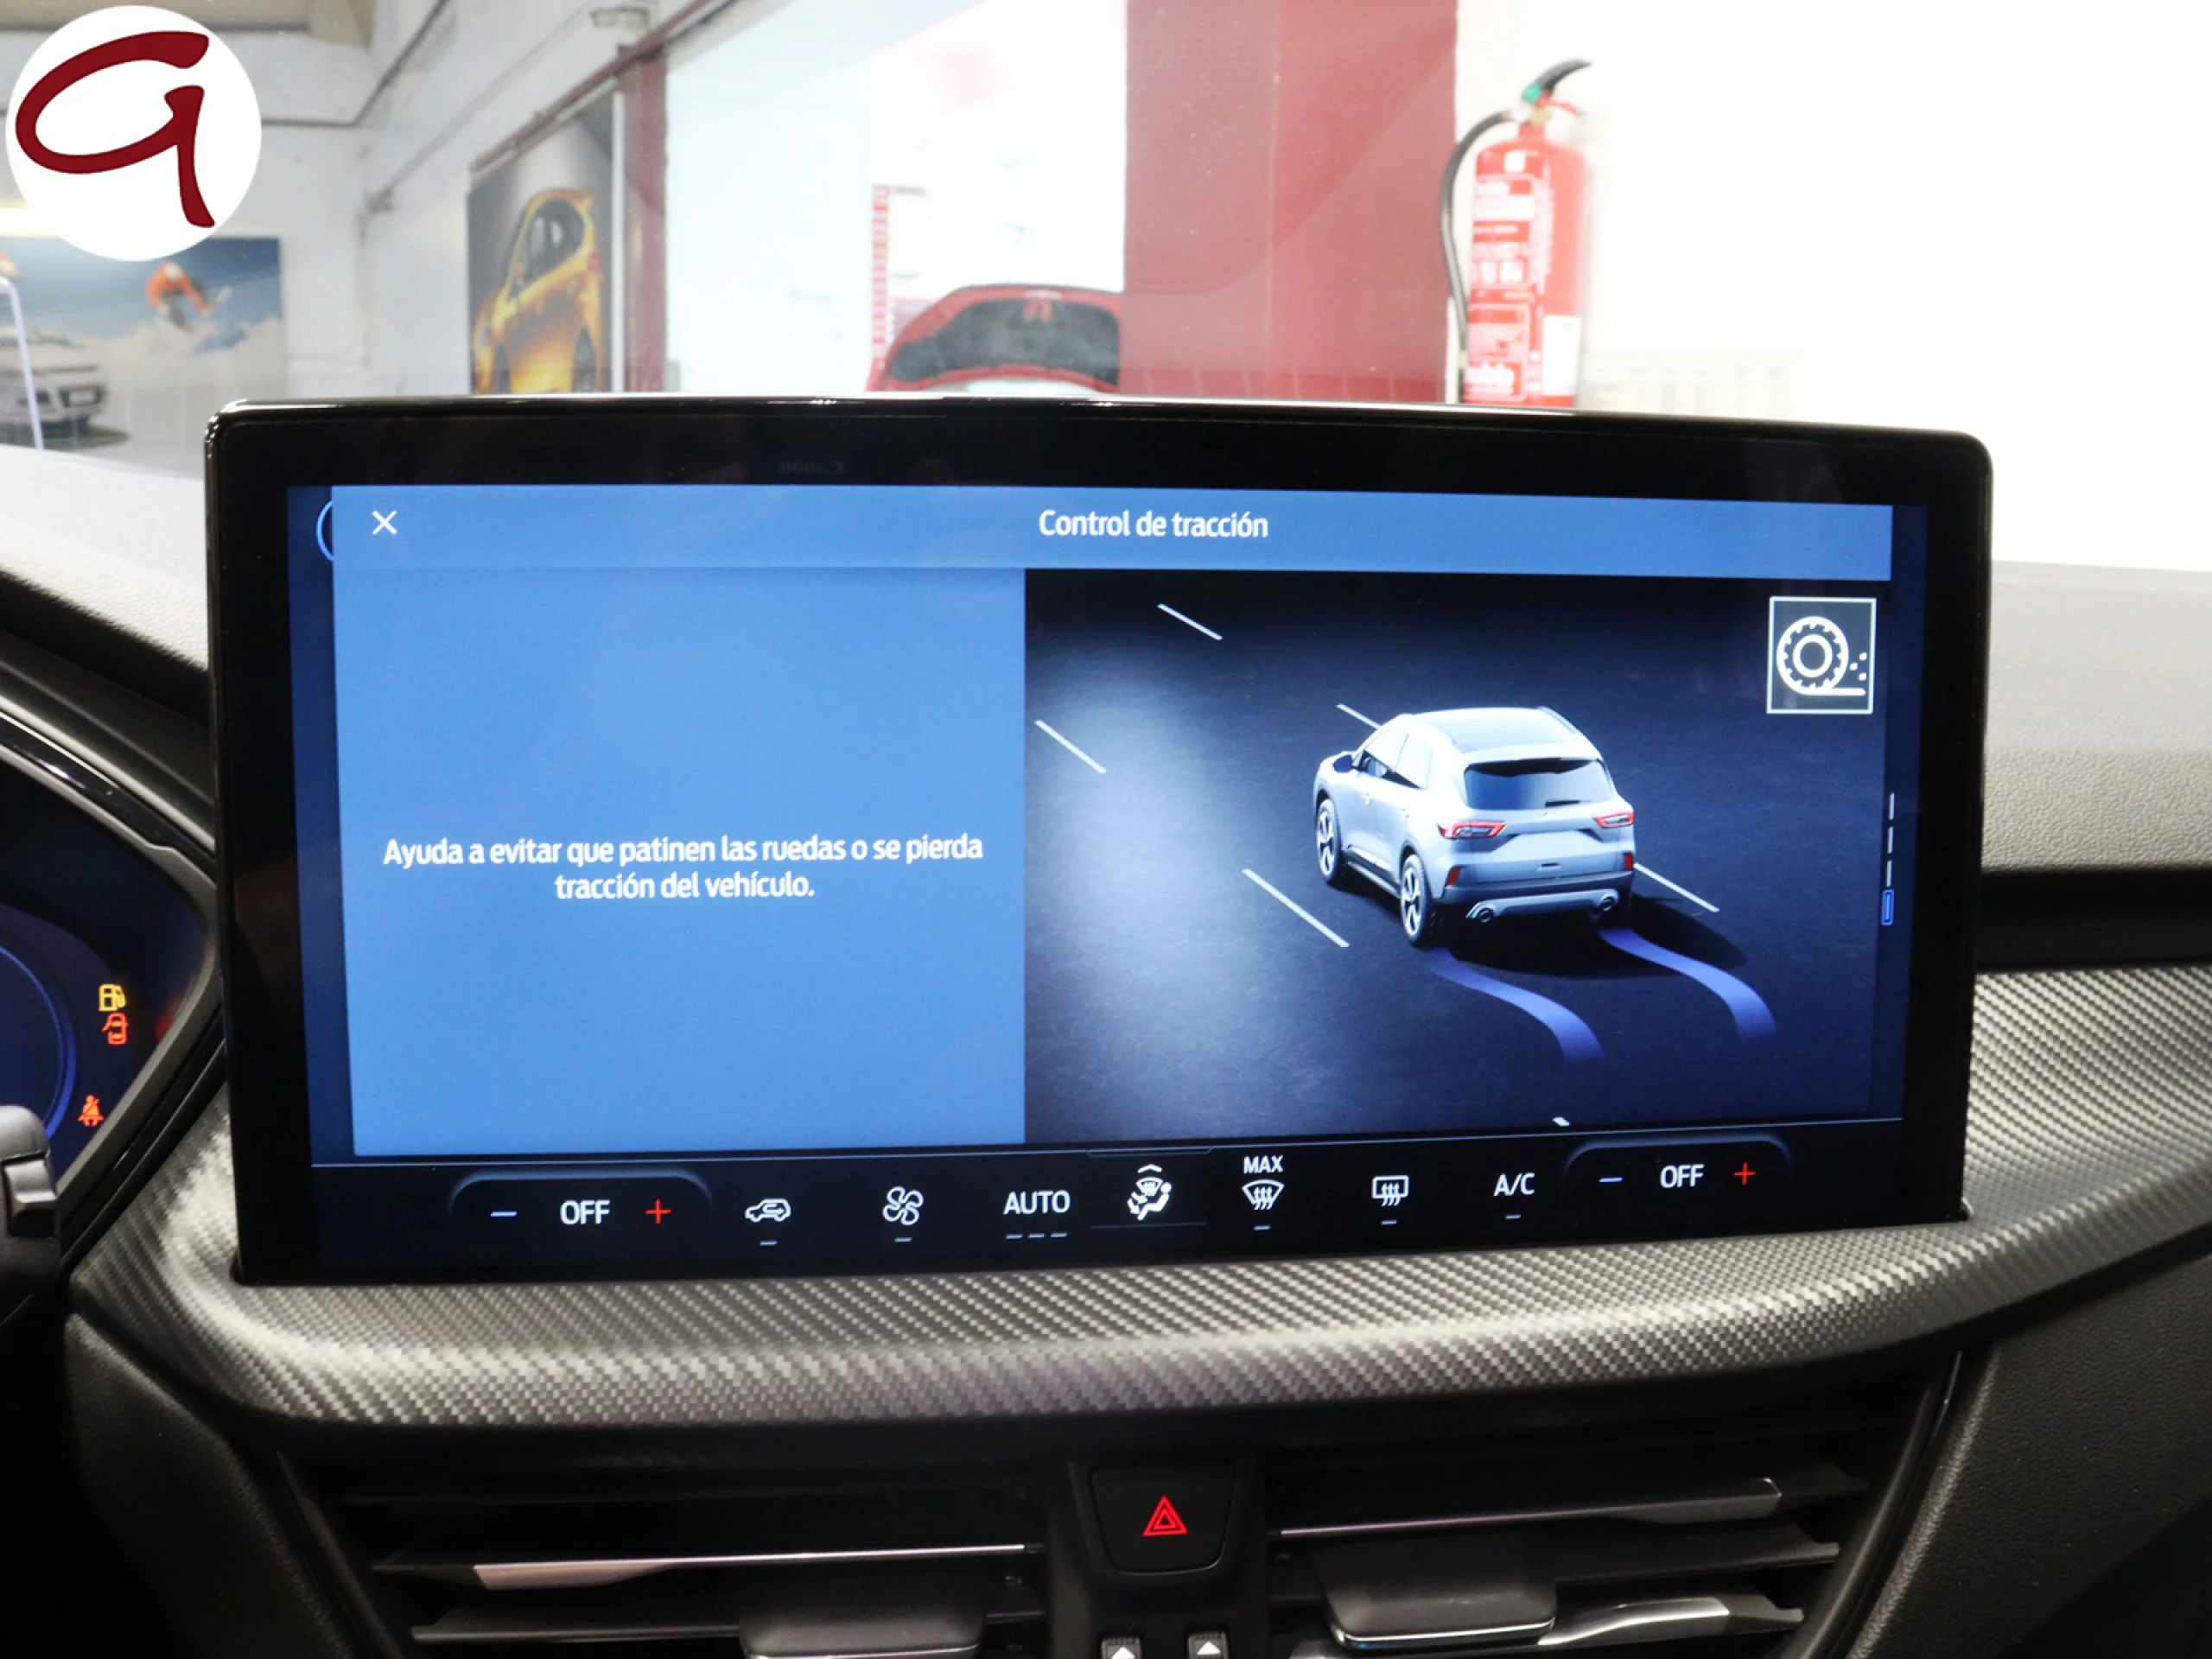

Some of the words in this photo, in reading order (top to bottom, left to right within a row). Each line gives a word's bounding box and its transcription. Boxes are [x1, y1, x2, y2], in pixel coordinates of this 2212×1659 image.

[1039, 509, 1131, 537] Control
[1135, 510, 1167, 537] de
[1171, 511, 1268, 538] tracción
[383, 837, 464, 869] Ayuda
[467, 842, 486, 865] a
[489, 837, 563, 865] evitar
[566, 842, 615, 868] que
[619, 836, 715, 868] patinen
[720, 834, 758, 862] las
[762, 834, 847, 861] ruedas
[850, 839, 868, 861] o
[873, 839, 901, 861] se
[906, 832, 984, 865] pierda
[554, 871, 656, 899] tracción
[660, 871, 701, 899] del
[704, 870, 815, 899] vehículo.
[1243, 1154, 1284, 1174] MAX
[1659, 1163, 1706, 1189] OFF
[1493, 1172, 1536, 1198] A/C
[559, 1199, 611, 1225] OFF
[1002, 1190, 1071, 1215] AUTO
